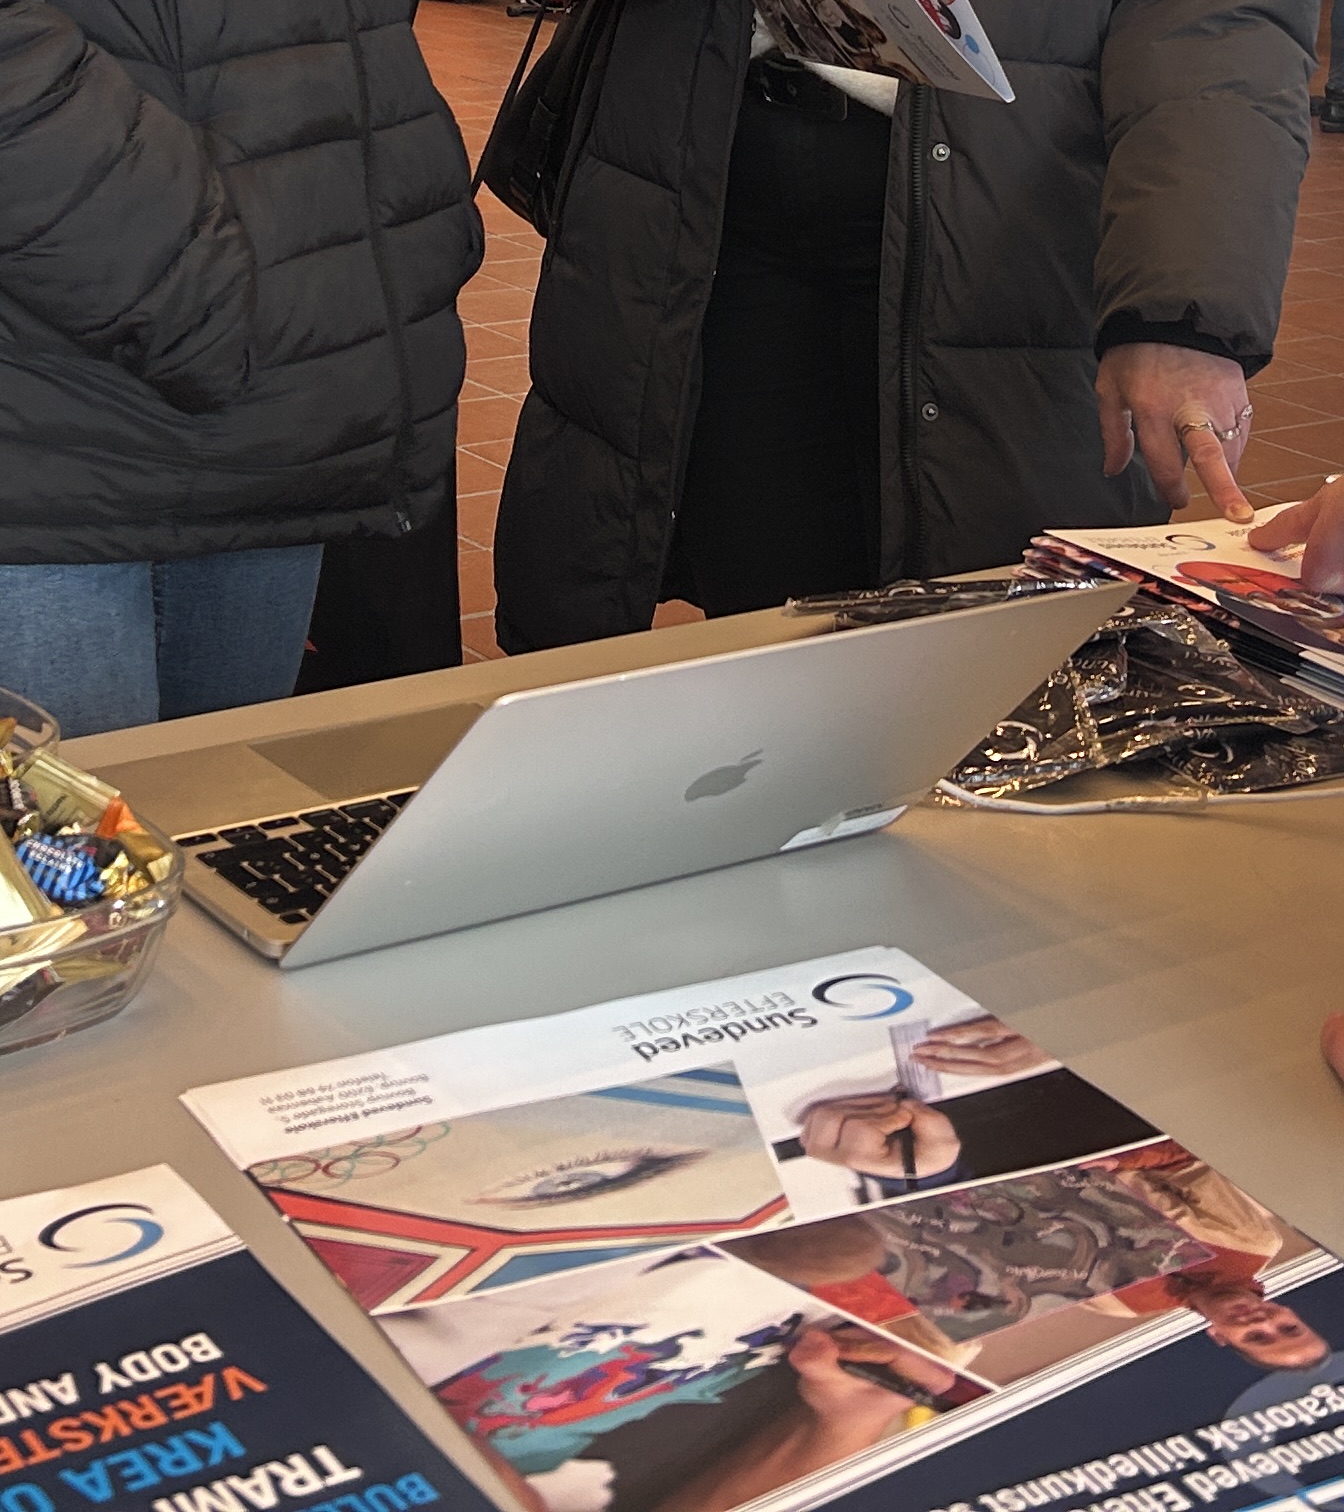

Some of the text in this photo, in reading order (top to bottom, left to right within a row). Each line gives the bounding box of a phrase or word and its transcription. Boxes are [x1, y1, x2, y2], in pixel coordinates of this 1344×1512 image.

[612, 991, 796, 1042] EFTERSKOLE
[631, 1007, 819, 1063] Sundeved
[93, 1332, 225, 1394] BODY
[59, 1420, 248, 1503] KREA
[978, 1434, 1207, 1512] billedkunst
